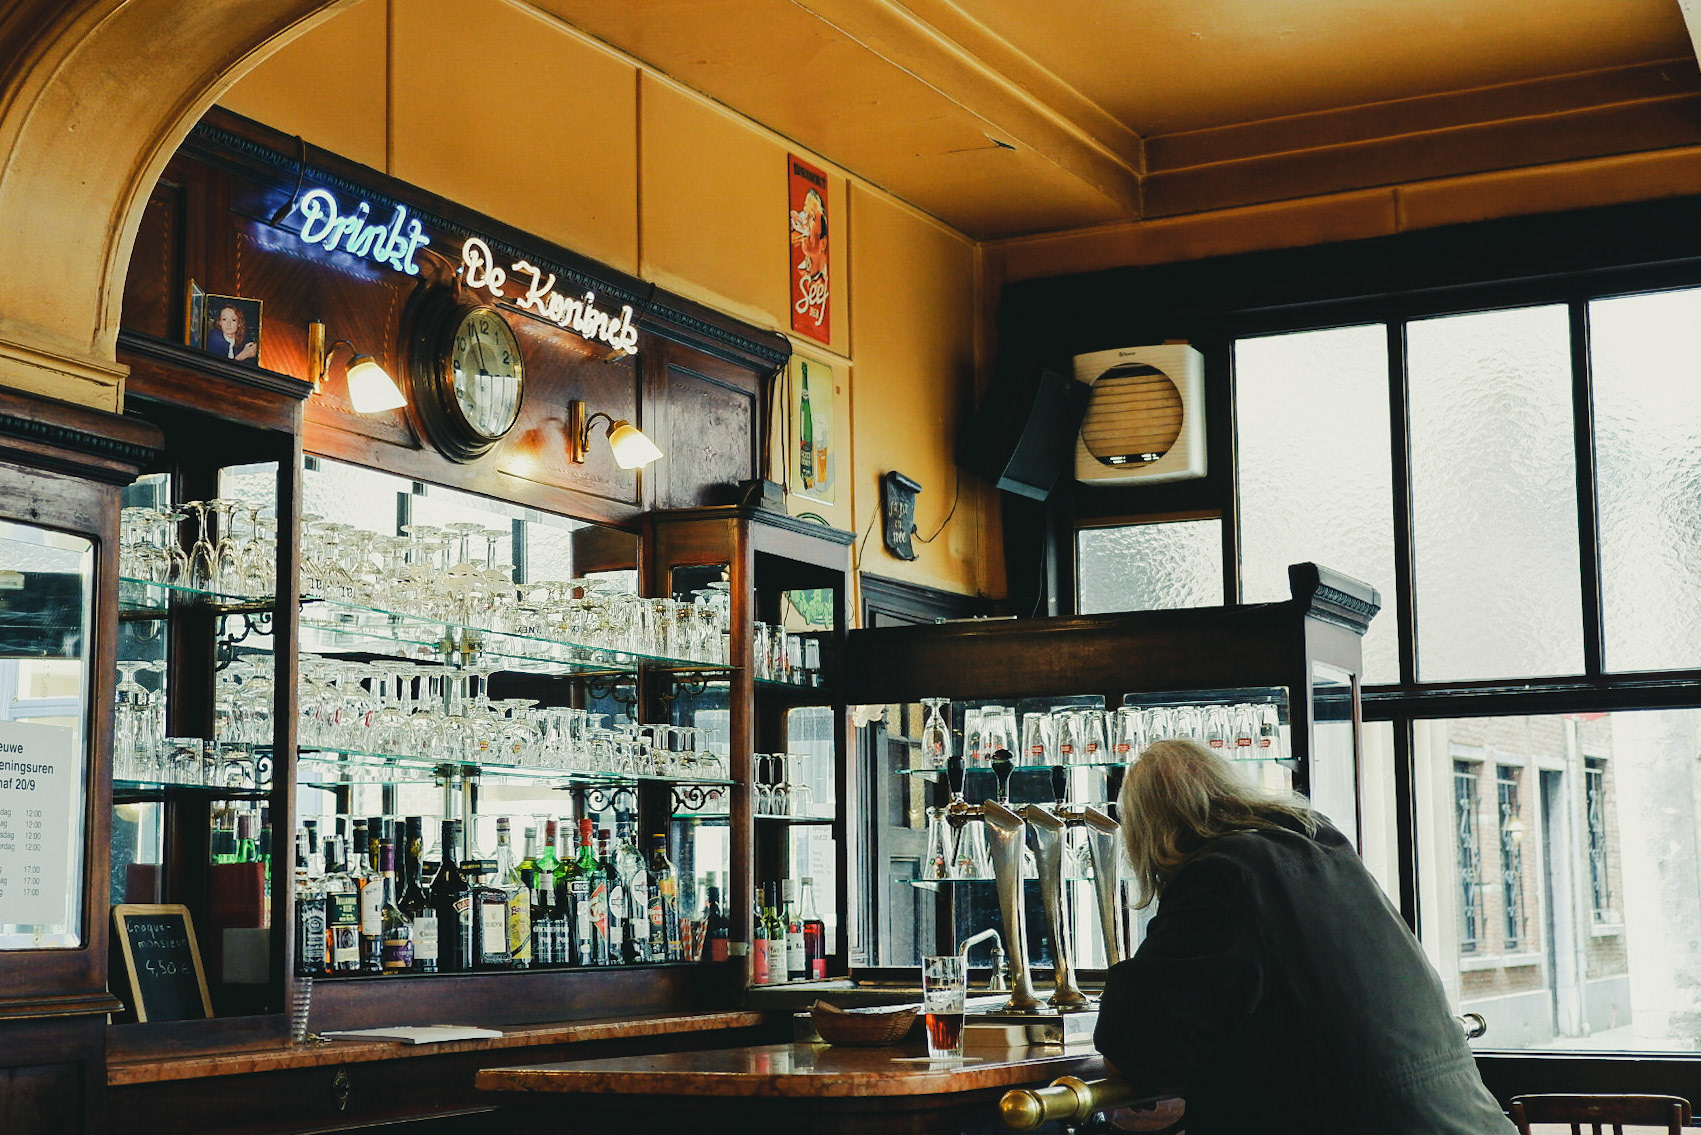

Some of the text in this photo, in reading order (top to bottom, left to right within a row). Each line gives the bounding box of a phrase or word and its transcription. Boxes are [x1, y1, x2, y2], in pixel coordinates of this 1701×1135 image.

[300, 189, 430, 276] Drinkt
[462, 237, 506, 297] De
[479, 319, 489, 335] 12
[457, 336, 467, 352] 10
[502, 350, 510, 365] 2
[15, 779, 35, 791] 20/9
[26, 810, 42, 818] 12:00
[25, 821, 42, 829] 12:00
[25, 832, 41, 840] 12:00
[25, 843, 41, 851] 12:00
[24, 866, 40, 874] 17:00
[23, 877, 40, 885] 17:00
[23, 888, 39, 896] 17:00
[146, 960, 176, 977] 4,50
